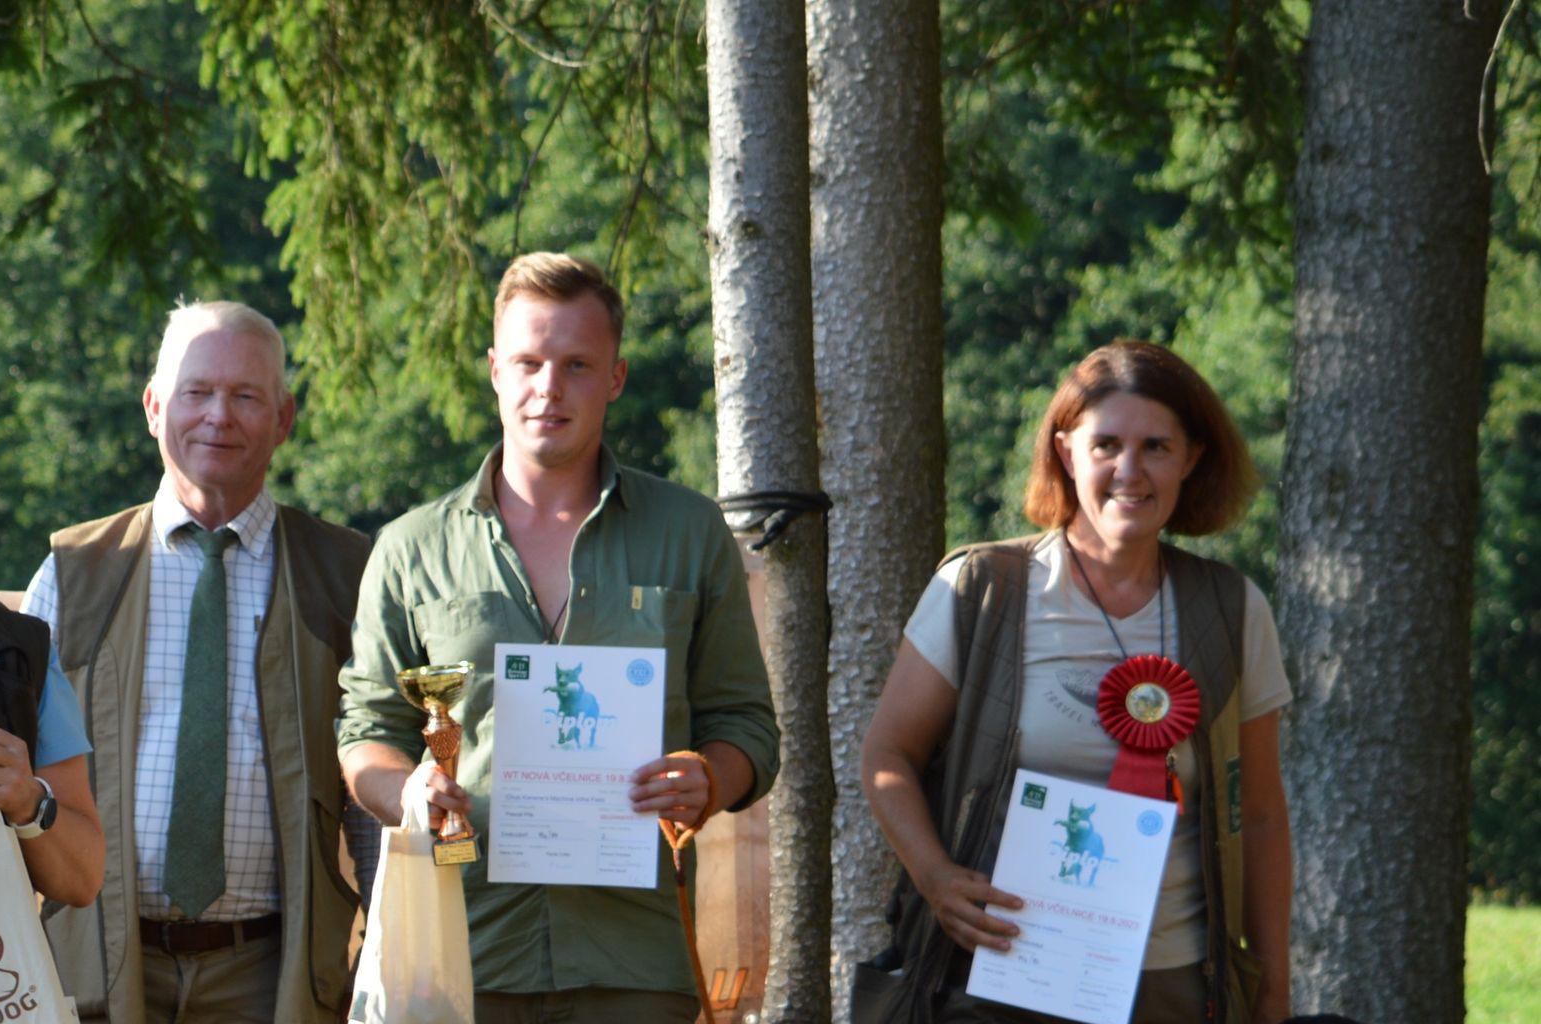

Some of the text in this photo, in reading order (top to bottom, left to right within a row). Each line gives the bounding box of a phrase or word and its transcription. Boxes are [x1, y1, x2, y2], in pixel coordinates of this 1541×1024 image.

[1043, 690, 1084, 723] TRAVEL
[503, 771, 518, 781] WT
[521, 770, 550, 782] NOVÁ
[553, 770, 602, 783] VČELNICE
[1047, 902, 1095, 922] VČELNICE
